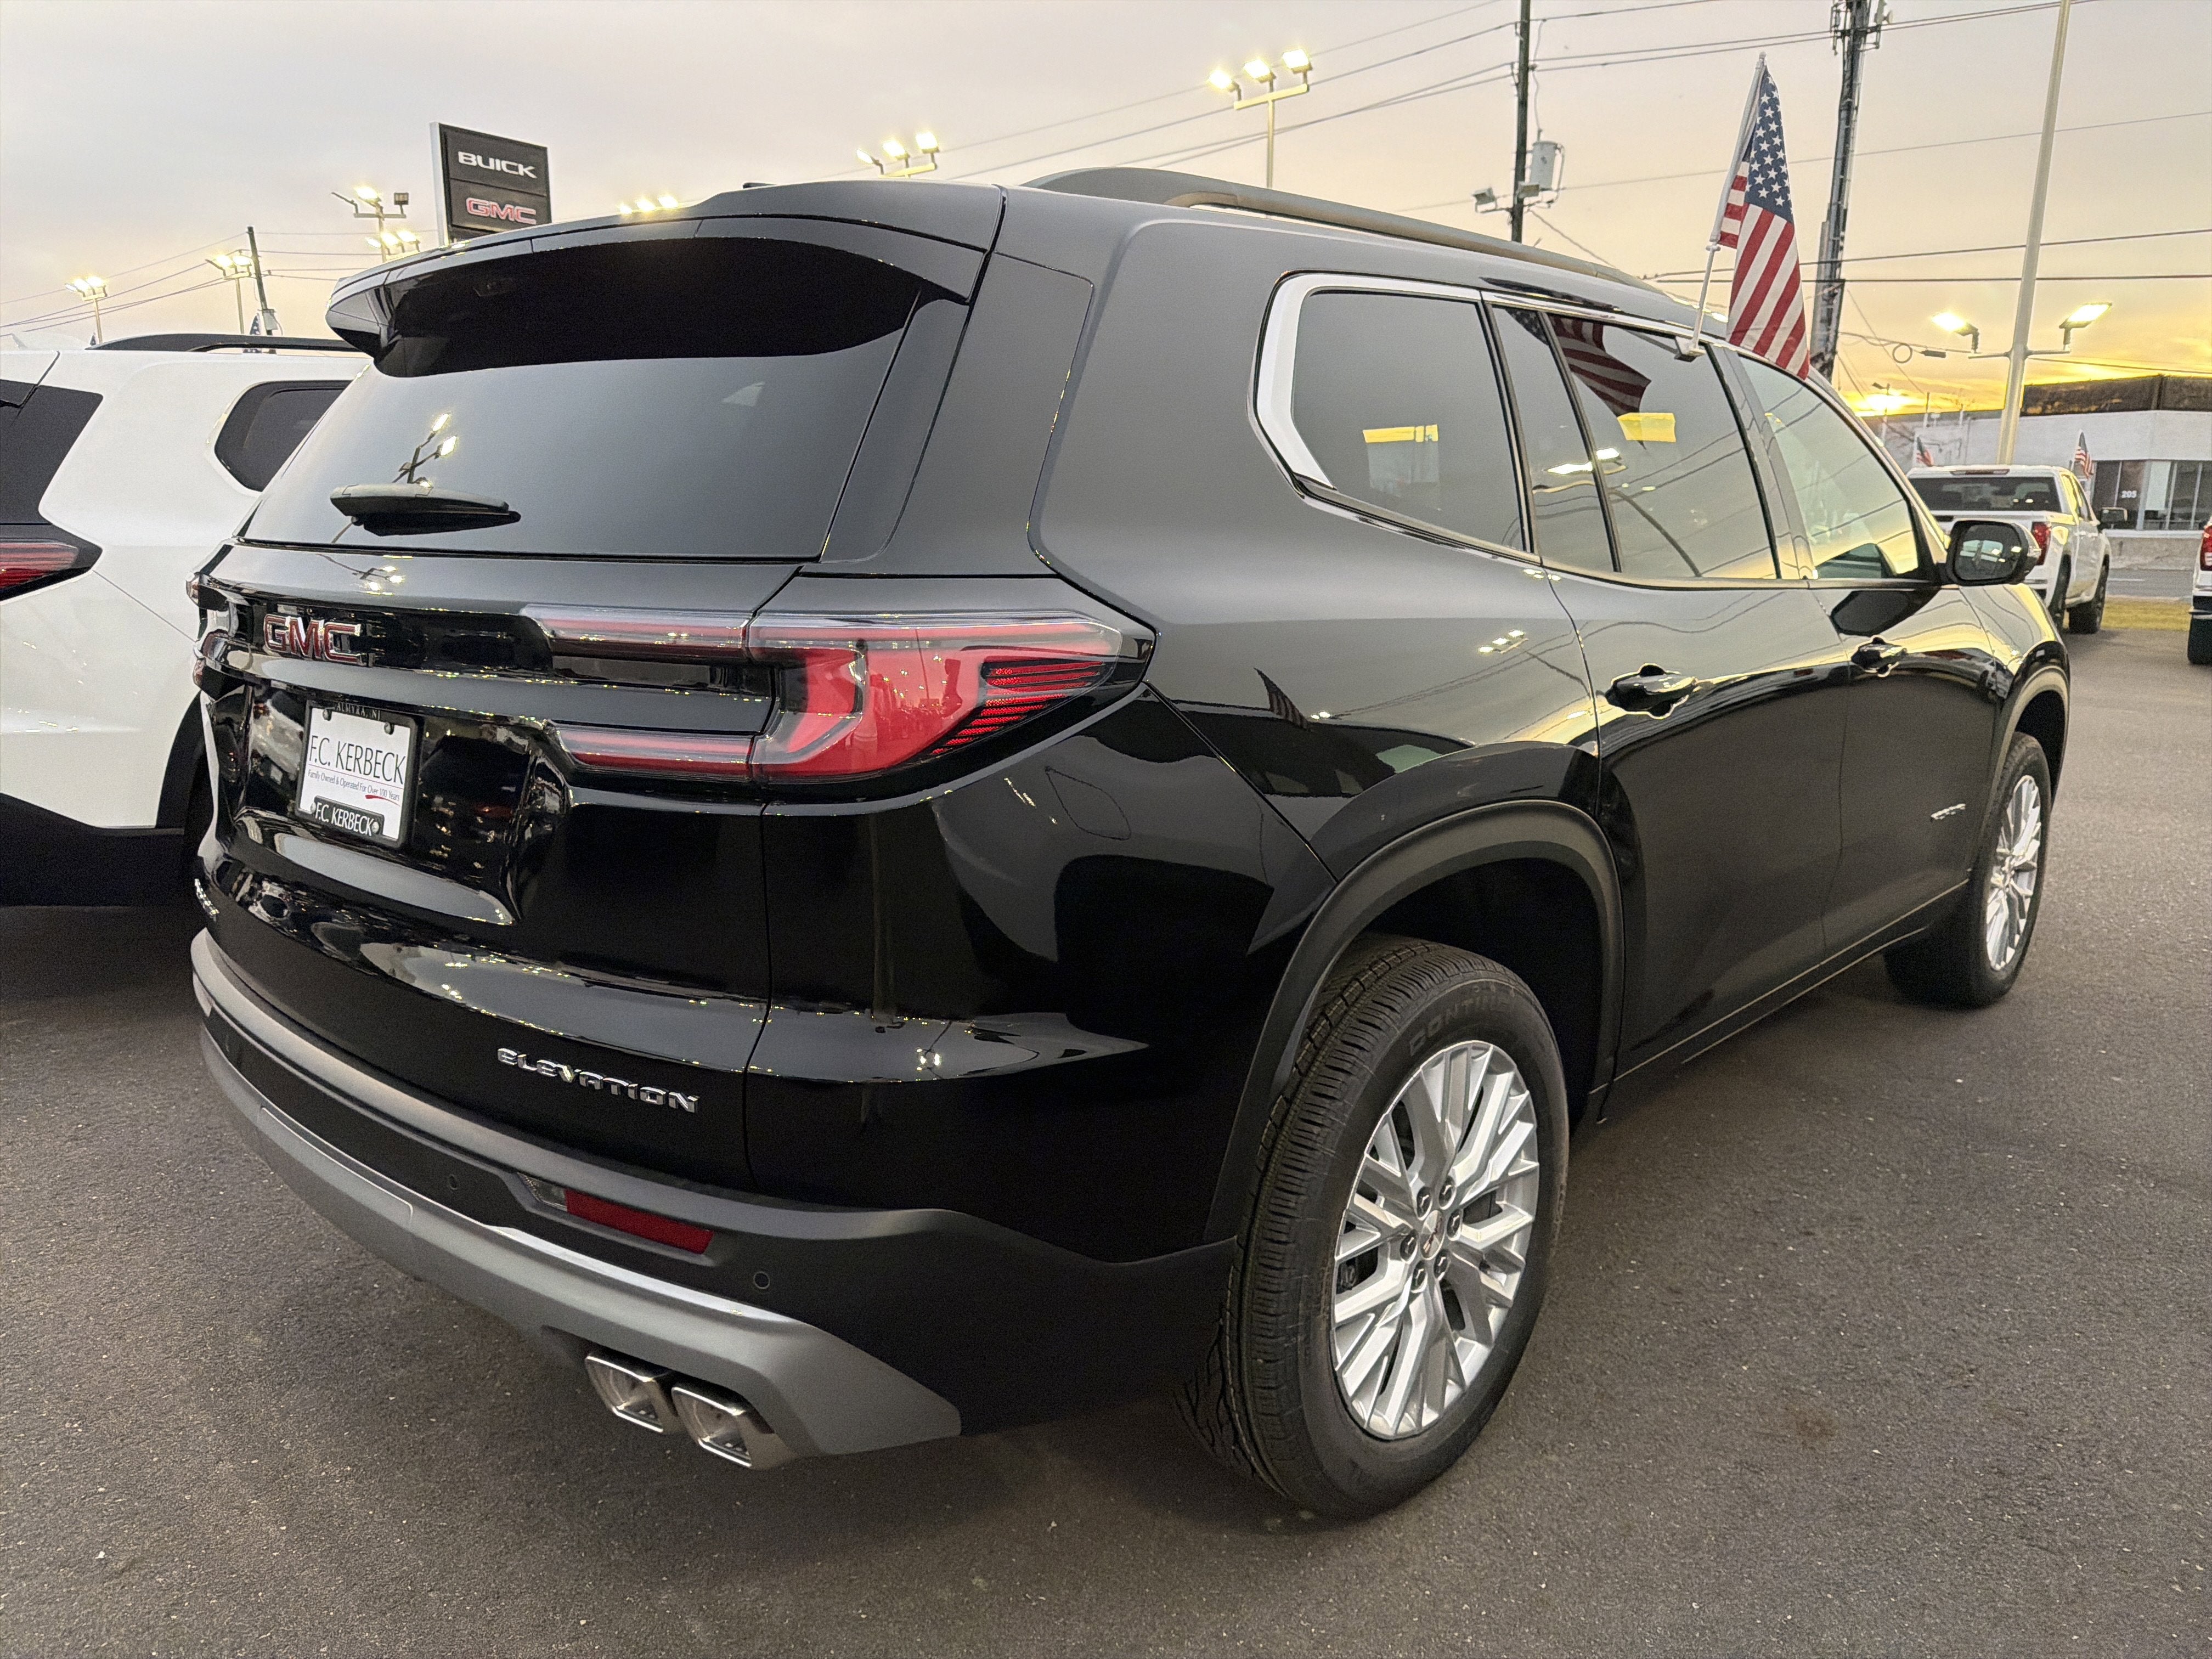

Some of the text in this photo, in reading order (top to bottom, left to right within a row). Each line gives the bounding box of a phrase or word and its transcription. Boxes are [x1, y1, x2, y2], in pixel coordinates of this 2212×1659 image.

[458, 151, 538, 179] BUICK
[466, 197, 537, 225] GMC
[263, 613, 366, 665] GMC
[334, 702, 368, 718] ALMYRA,
[309, 735, 406, 785] F.C. KERBECK
[308, 769, 320, 782] Family
[320, 773, 336, 784] Owned
[335, 776, 339, 785] &
[340, 778, 359, 791] Operated
[367, 785, 379, 795] Over
[380, 788, 388, 797] 100
[388, 790, 400, 802] Years
[331, 807, 374, 837] KERBECK
[497, 1047, 701, 1113] ELEVATION
